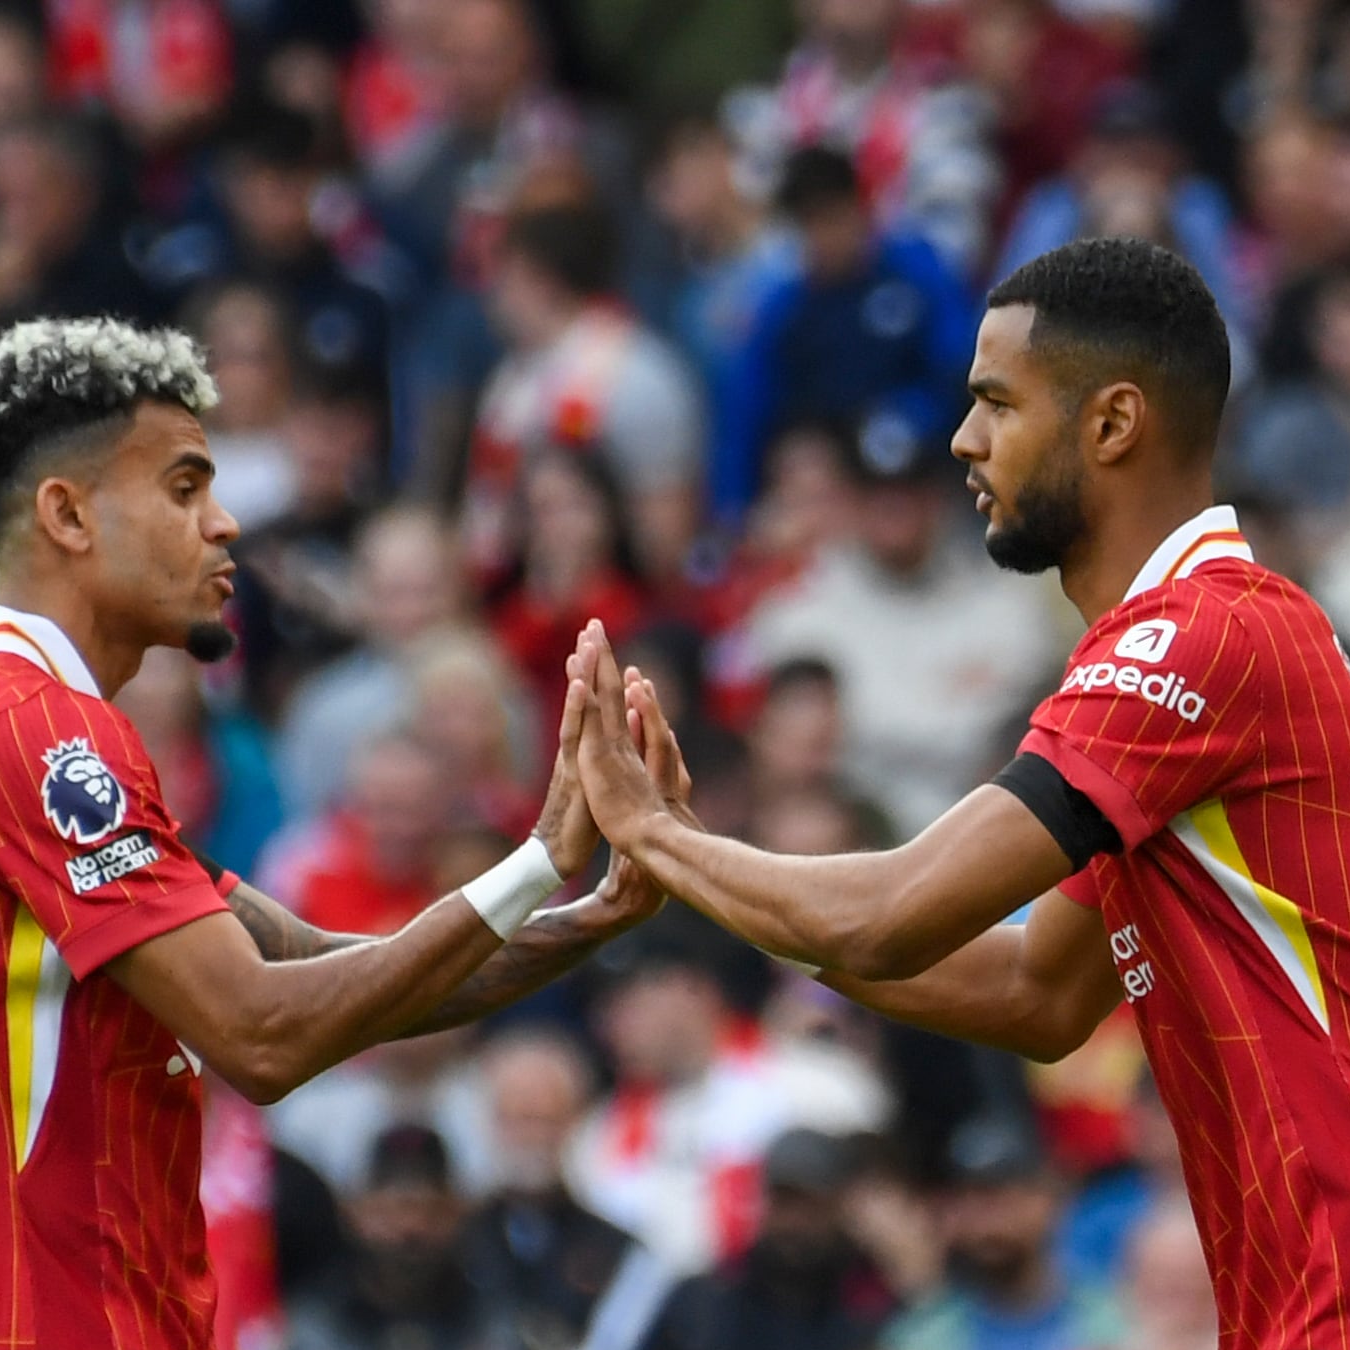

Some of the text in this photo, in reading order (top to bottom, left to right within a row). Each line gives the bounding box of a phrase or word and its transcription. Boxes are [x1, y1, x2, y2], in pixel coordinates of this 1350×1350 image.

[65, 834, 144, 877] No room
[69, 846, 159, 895] for racism
